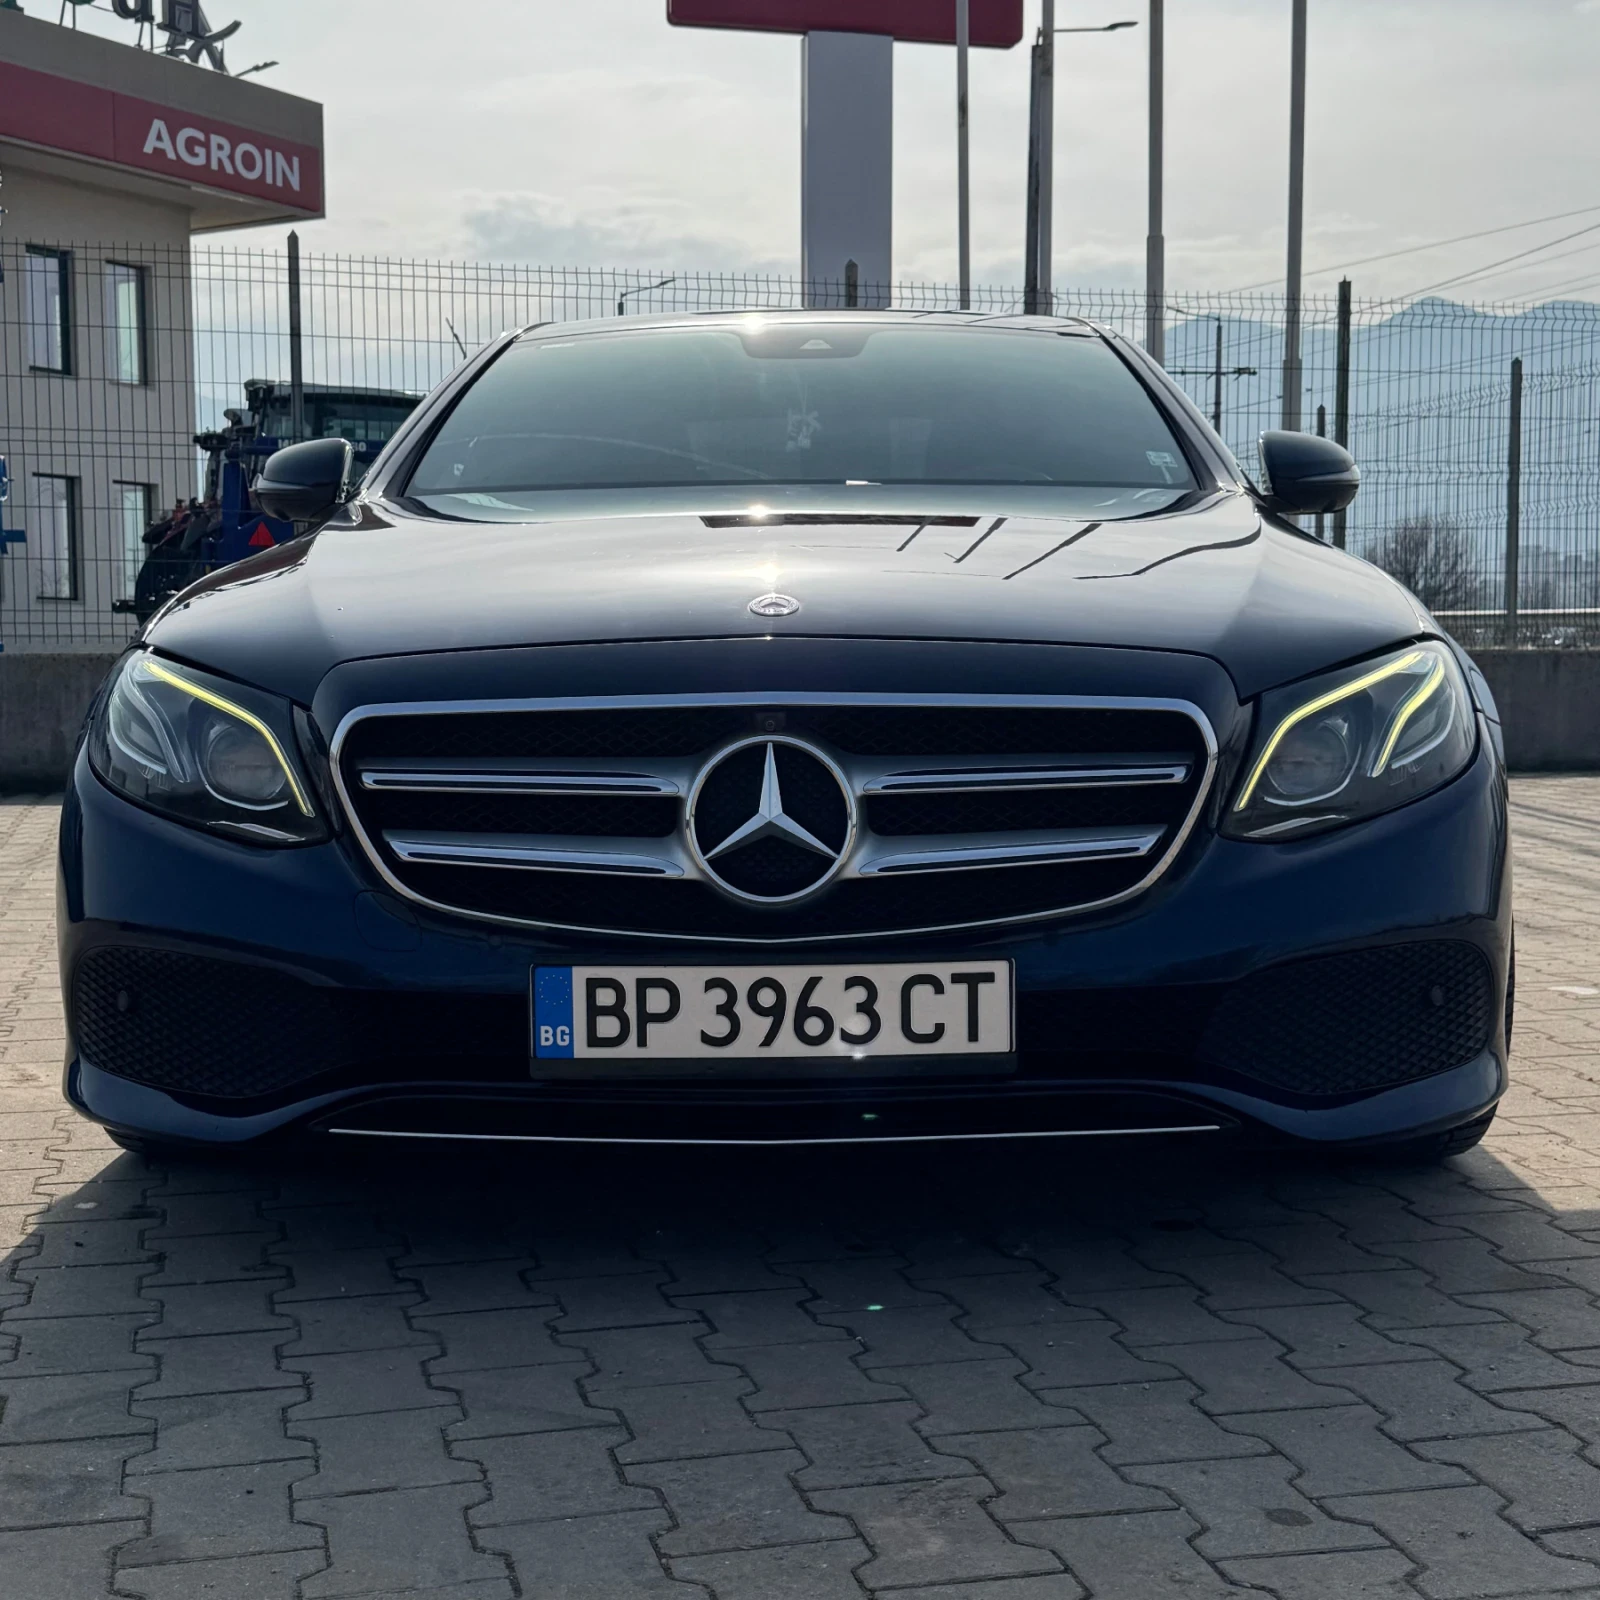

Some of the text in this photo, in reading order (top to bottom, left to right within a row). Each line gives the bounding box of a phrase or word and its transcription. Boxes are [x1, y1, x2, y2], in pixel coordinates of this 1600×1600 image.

[143, 118, 300, 192] AGROIN
[540, 1025, 571, 1046] BG
[585, 972, 995, 1048] BP 3963 CT
